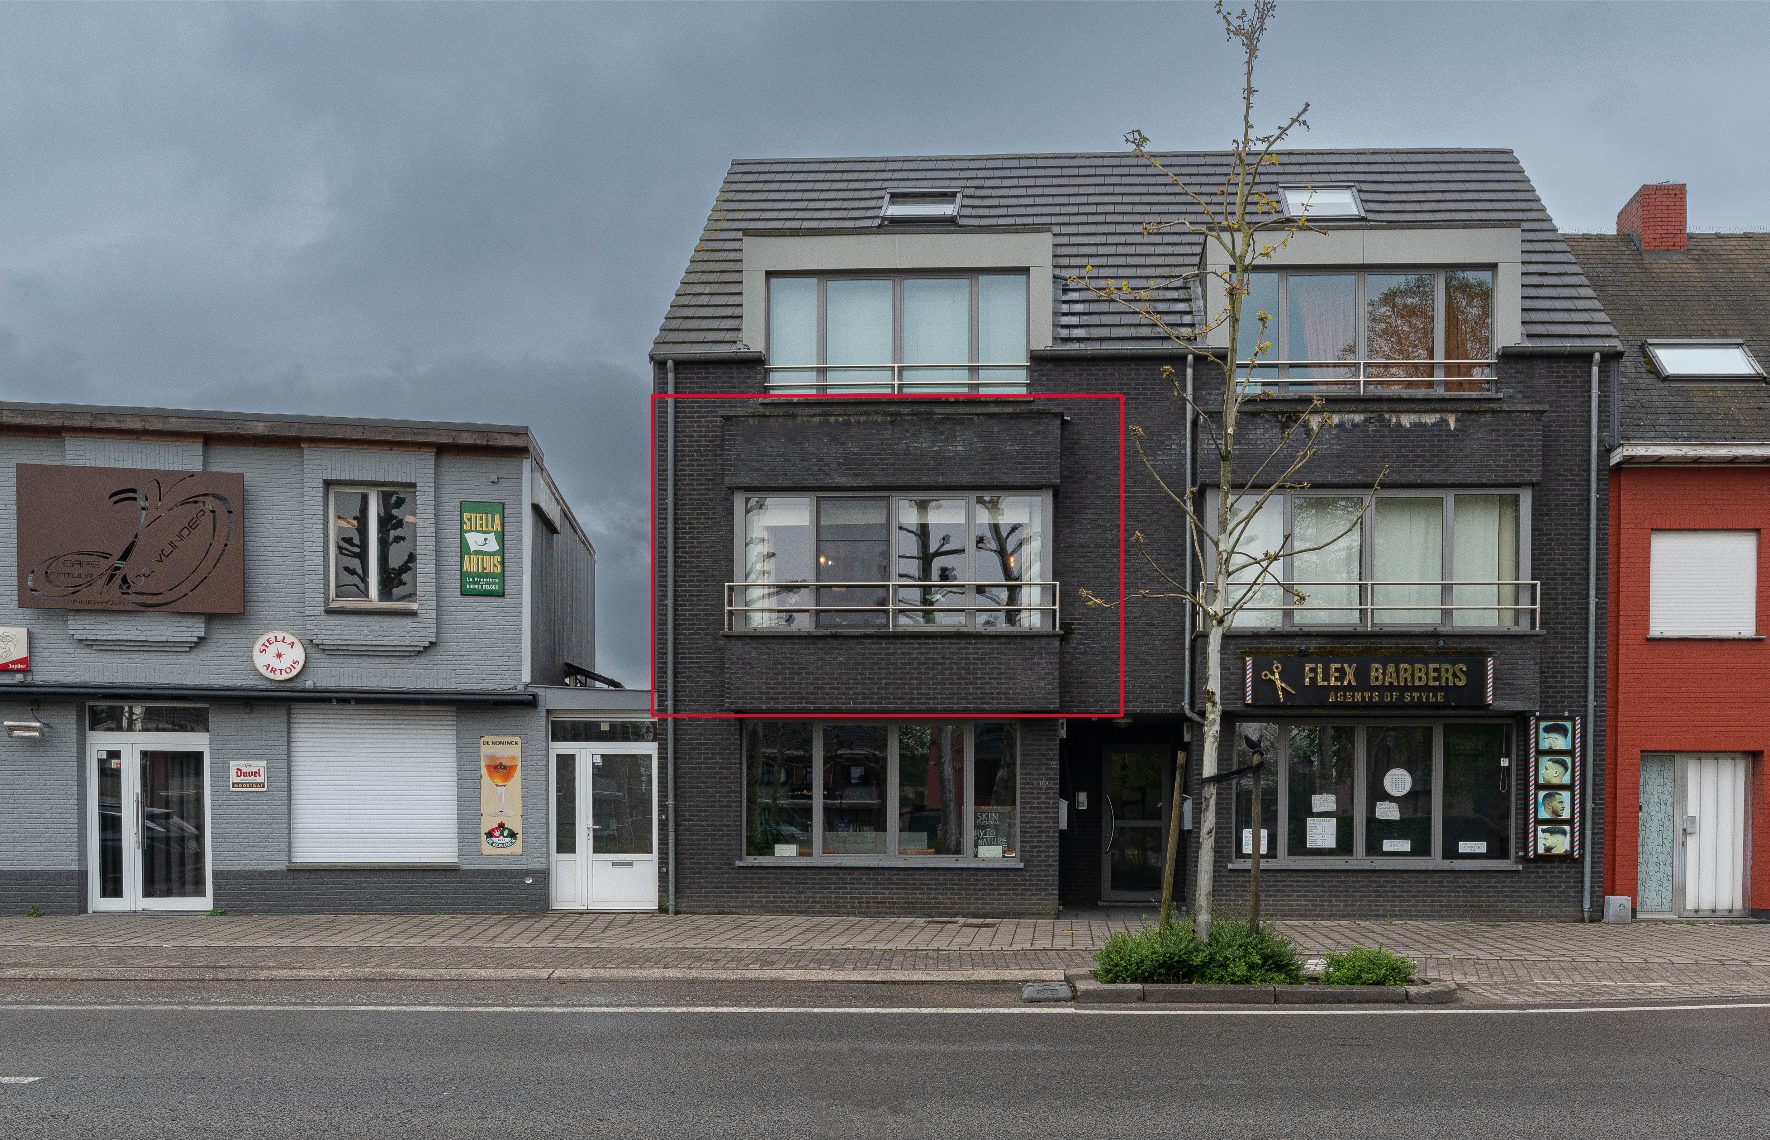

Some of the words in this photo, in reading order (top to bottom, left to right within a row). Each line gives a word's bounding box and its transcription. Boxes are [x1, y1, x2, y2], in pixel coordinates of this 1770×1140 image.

[463, 512, 501, 532] STELLA
[155, 508, 206, 563] VLINDER
[463, 554, 501, 573] ARTOIS
[259, 635, 295, 654] STELLA
[263, 659, 300, 676] ARTOIS
[1303, 663, 1358, 686] FLEX
[1369, 663, 1468, 686] BARBERS
[1328, 691, 1379, 702] AGENTS
[1383, 691, 1399, 702] OF
[1404, 691, 1445, 702] STYLE
[235, 767, 261, 778] Duvel
[976, 812, 999, 820] SKIN
